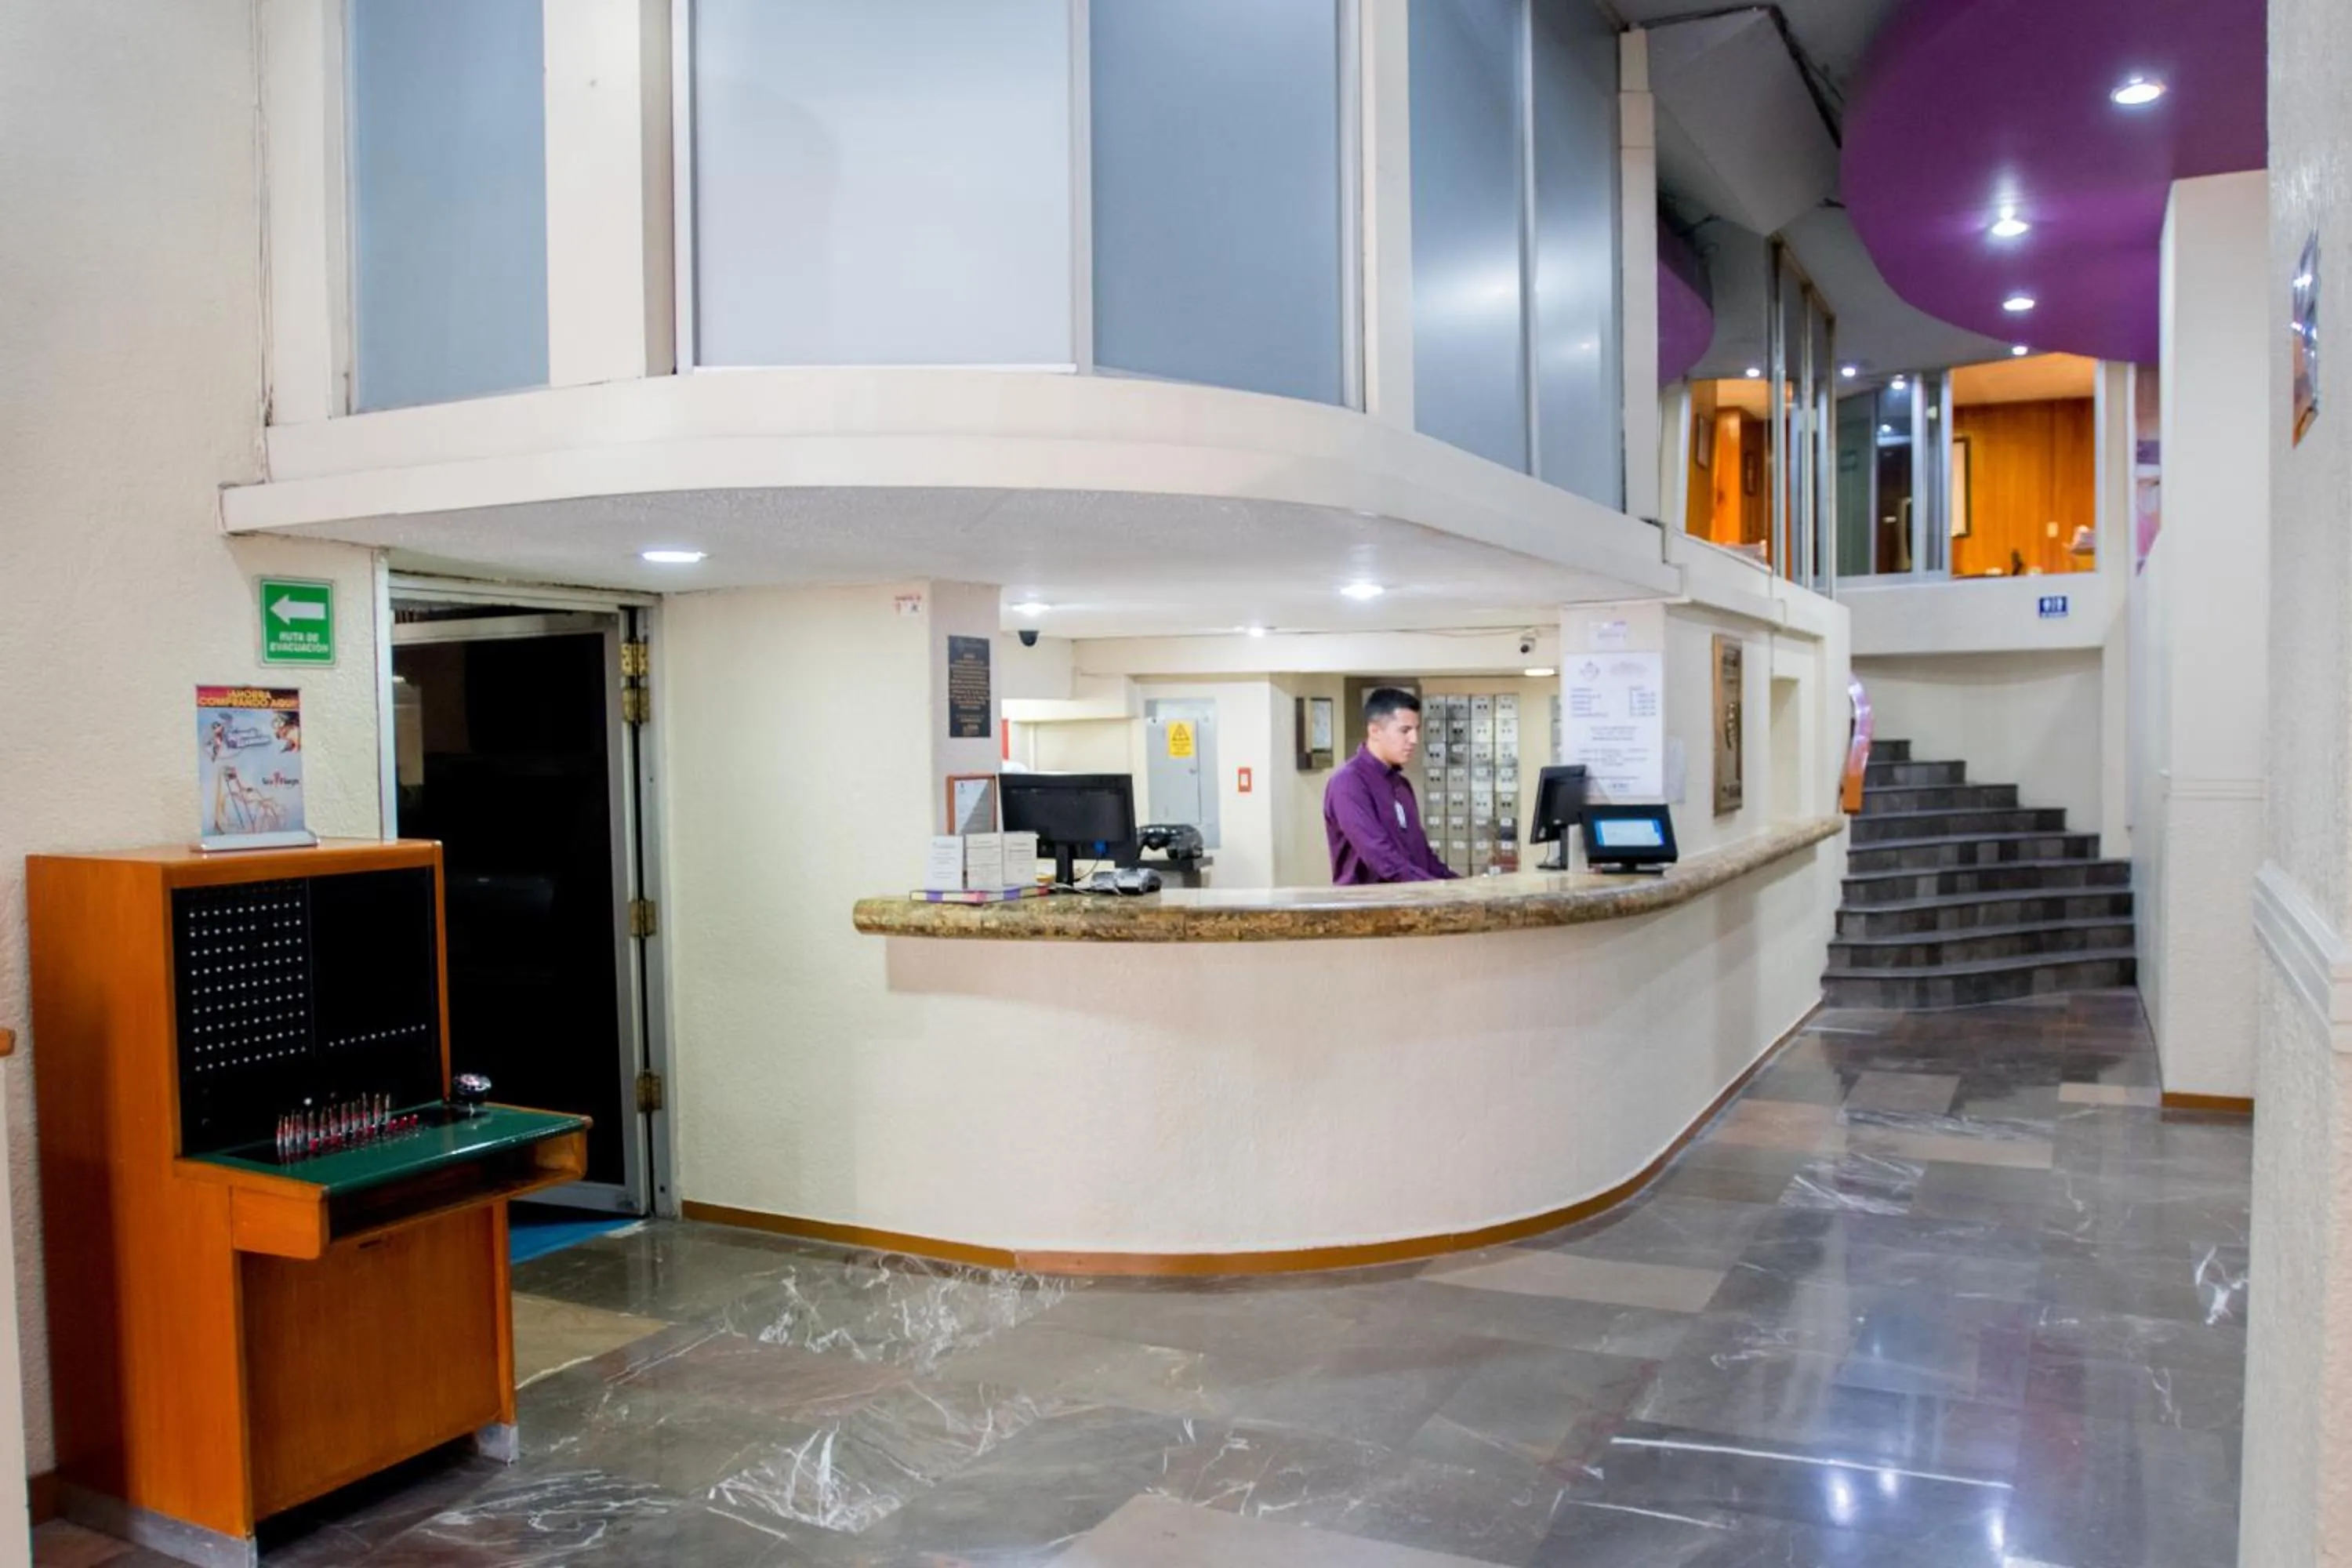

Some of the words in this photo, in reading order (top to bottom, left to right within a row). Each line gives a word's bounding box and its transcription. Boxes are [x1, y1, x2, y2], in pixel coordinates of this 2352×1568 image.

[279, 631, 304, 641] RUTA
[307, 632, 319, 643] DE
[198, 696, 269, 707] COMPRANDO
